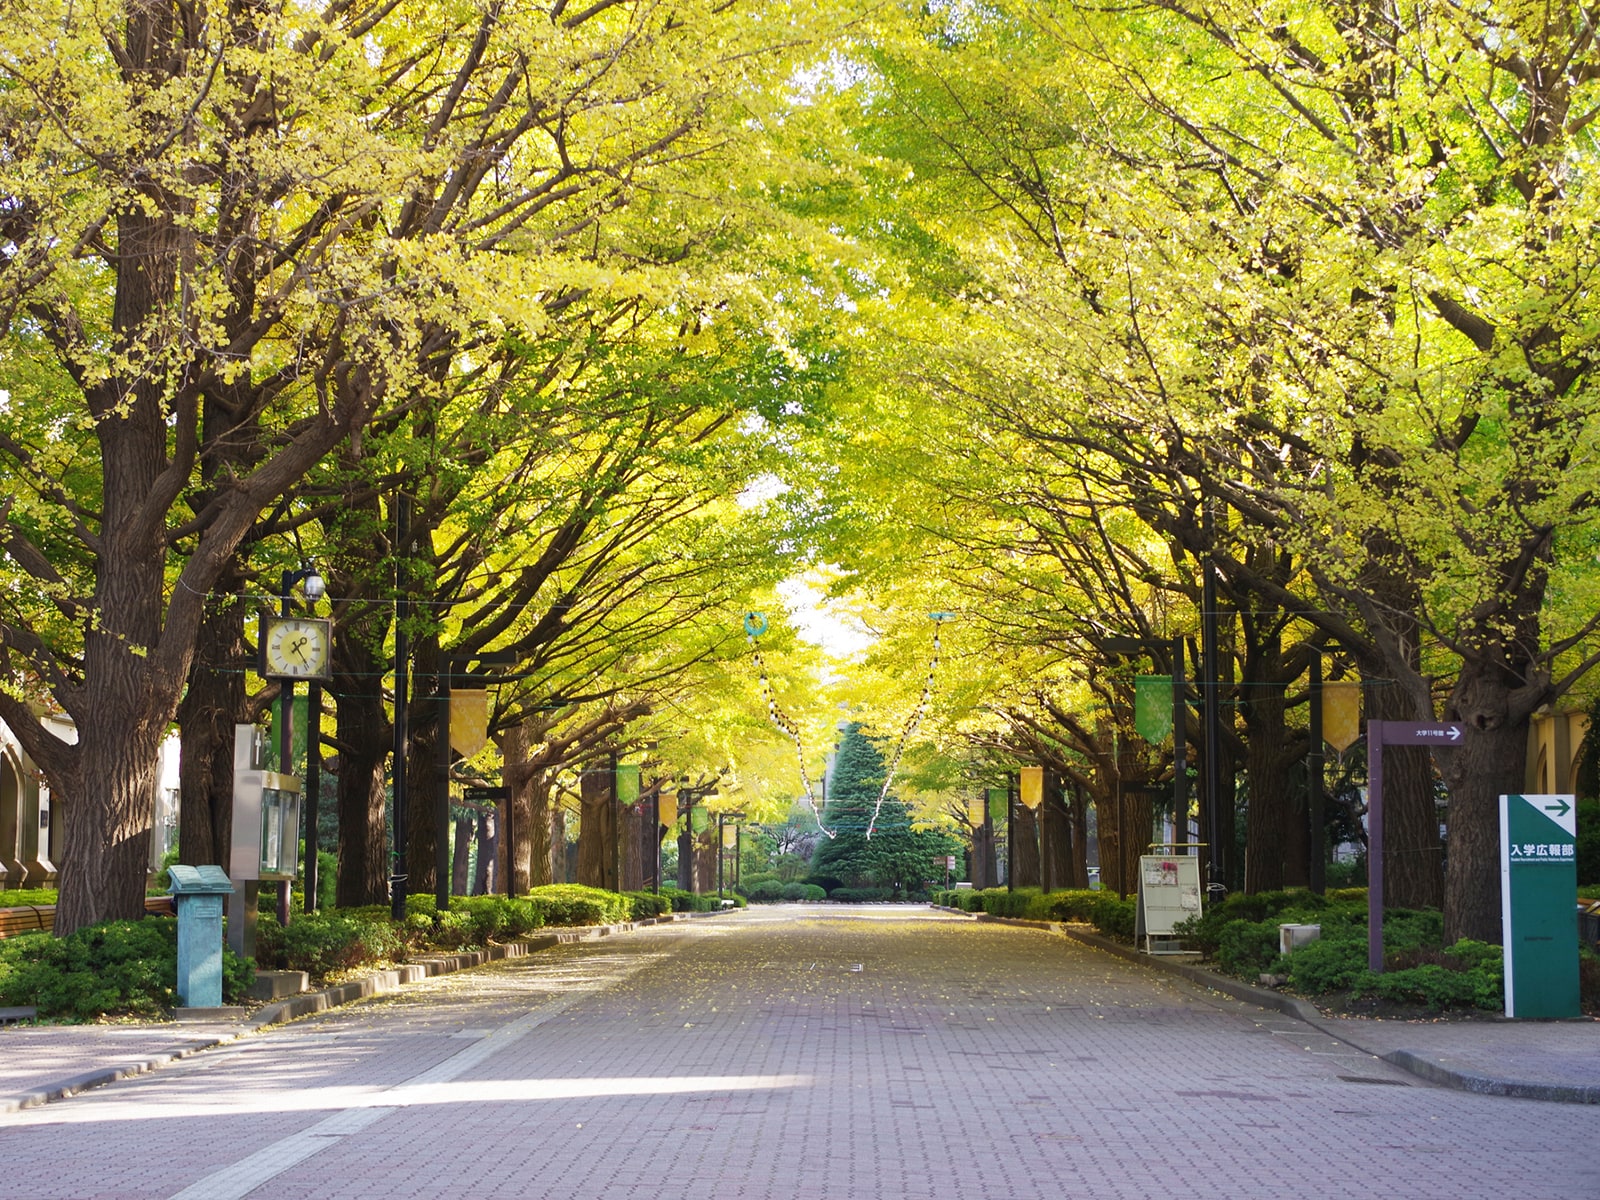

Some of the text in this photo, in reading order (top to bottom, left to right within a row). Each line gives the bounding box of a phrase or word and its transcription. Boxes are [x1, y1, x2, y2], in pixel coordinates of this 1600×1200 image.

[1510, 843, 1574, 856] 入学広報部
